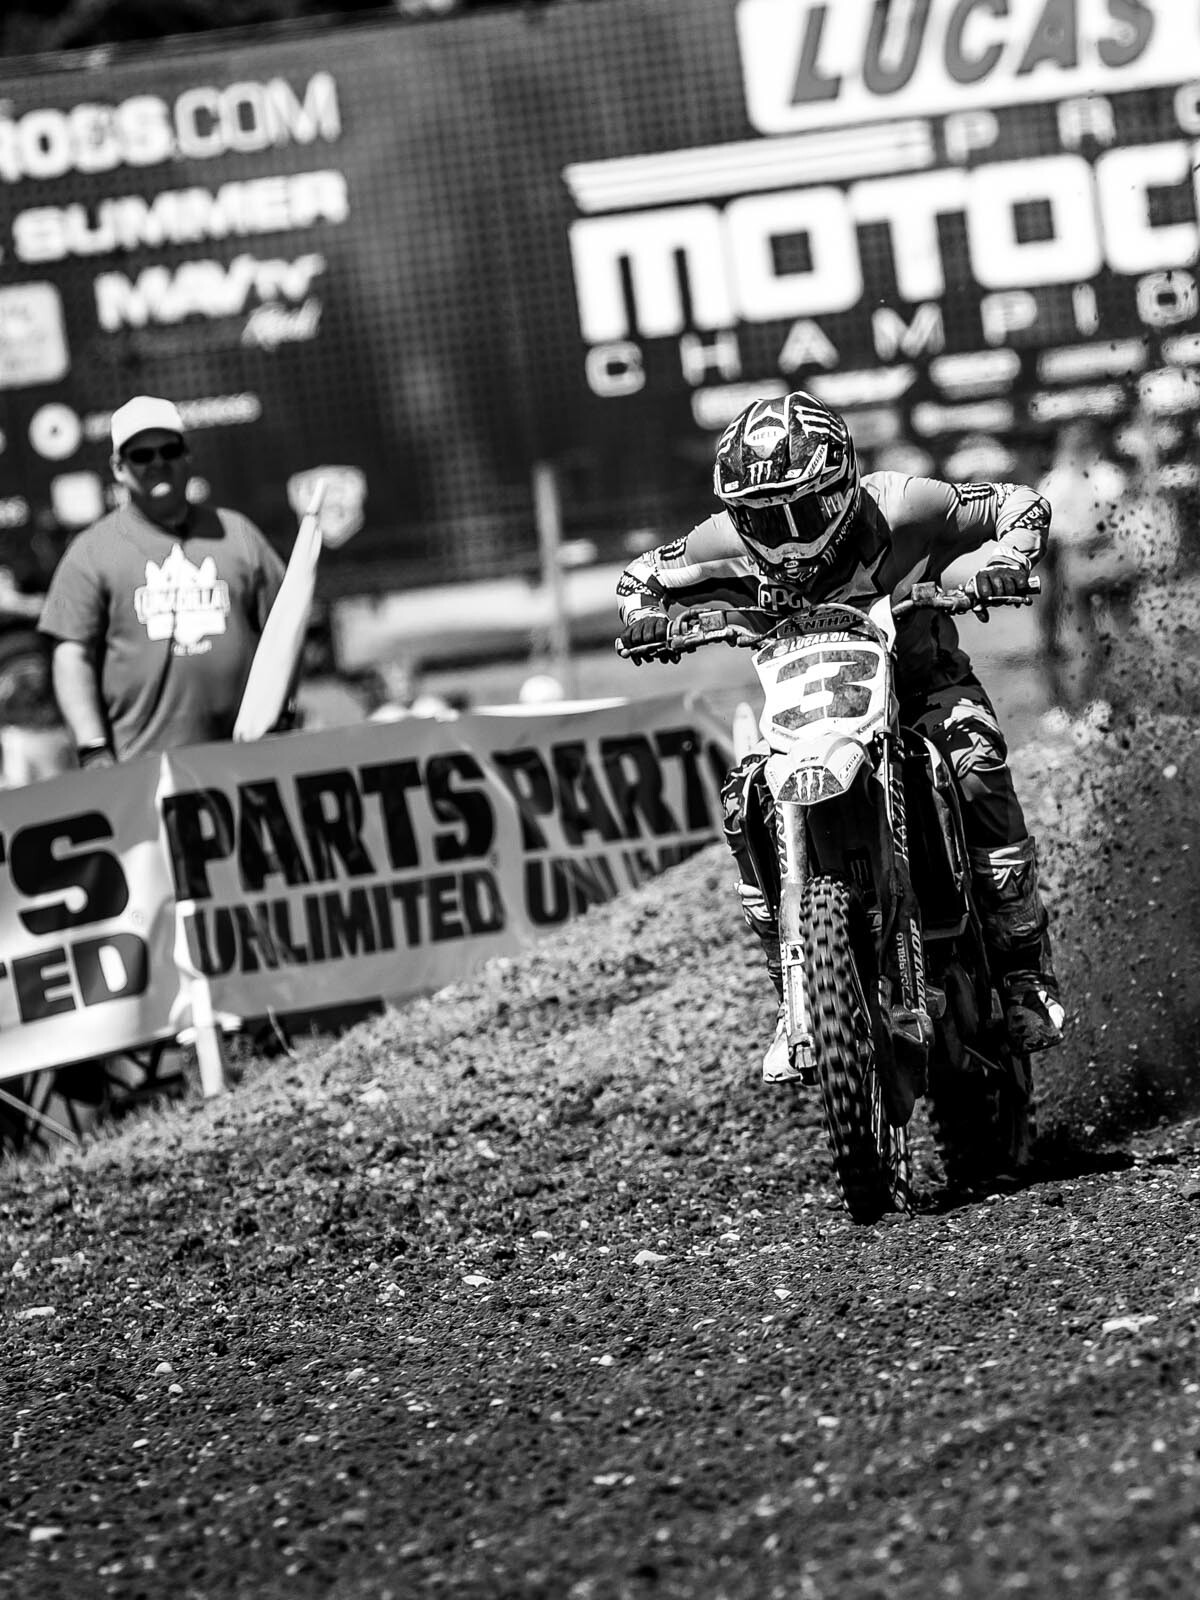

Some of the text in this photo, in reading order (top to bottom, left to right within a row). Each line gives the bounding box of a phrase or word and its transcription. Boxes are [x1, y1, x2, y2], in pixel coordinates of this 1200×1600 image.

[791, 0, 1154, 107] LUCAS
[12, 168, 350, 264] SUMMER
[760, 588, 801, 612] PPG
[784, 613, 862, 634] RENTHAL
[790, 632, 850, 650] LUCAS OIL
[772, 650, 880, 731] 3
[162, 750, 497, 902] PARTS
[491, 725, 736, 852] PART
[0, 809, 129, 936] S
[185, 867, 506, 978] UNLIMITED
[909, 918, 927, 1013] DUNLOP
[0, 931, 148, 1025] ED
